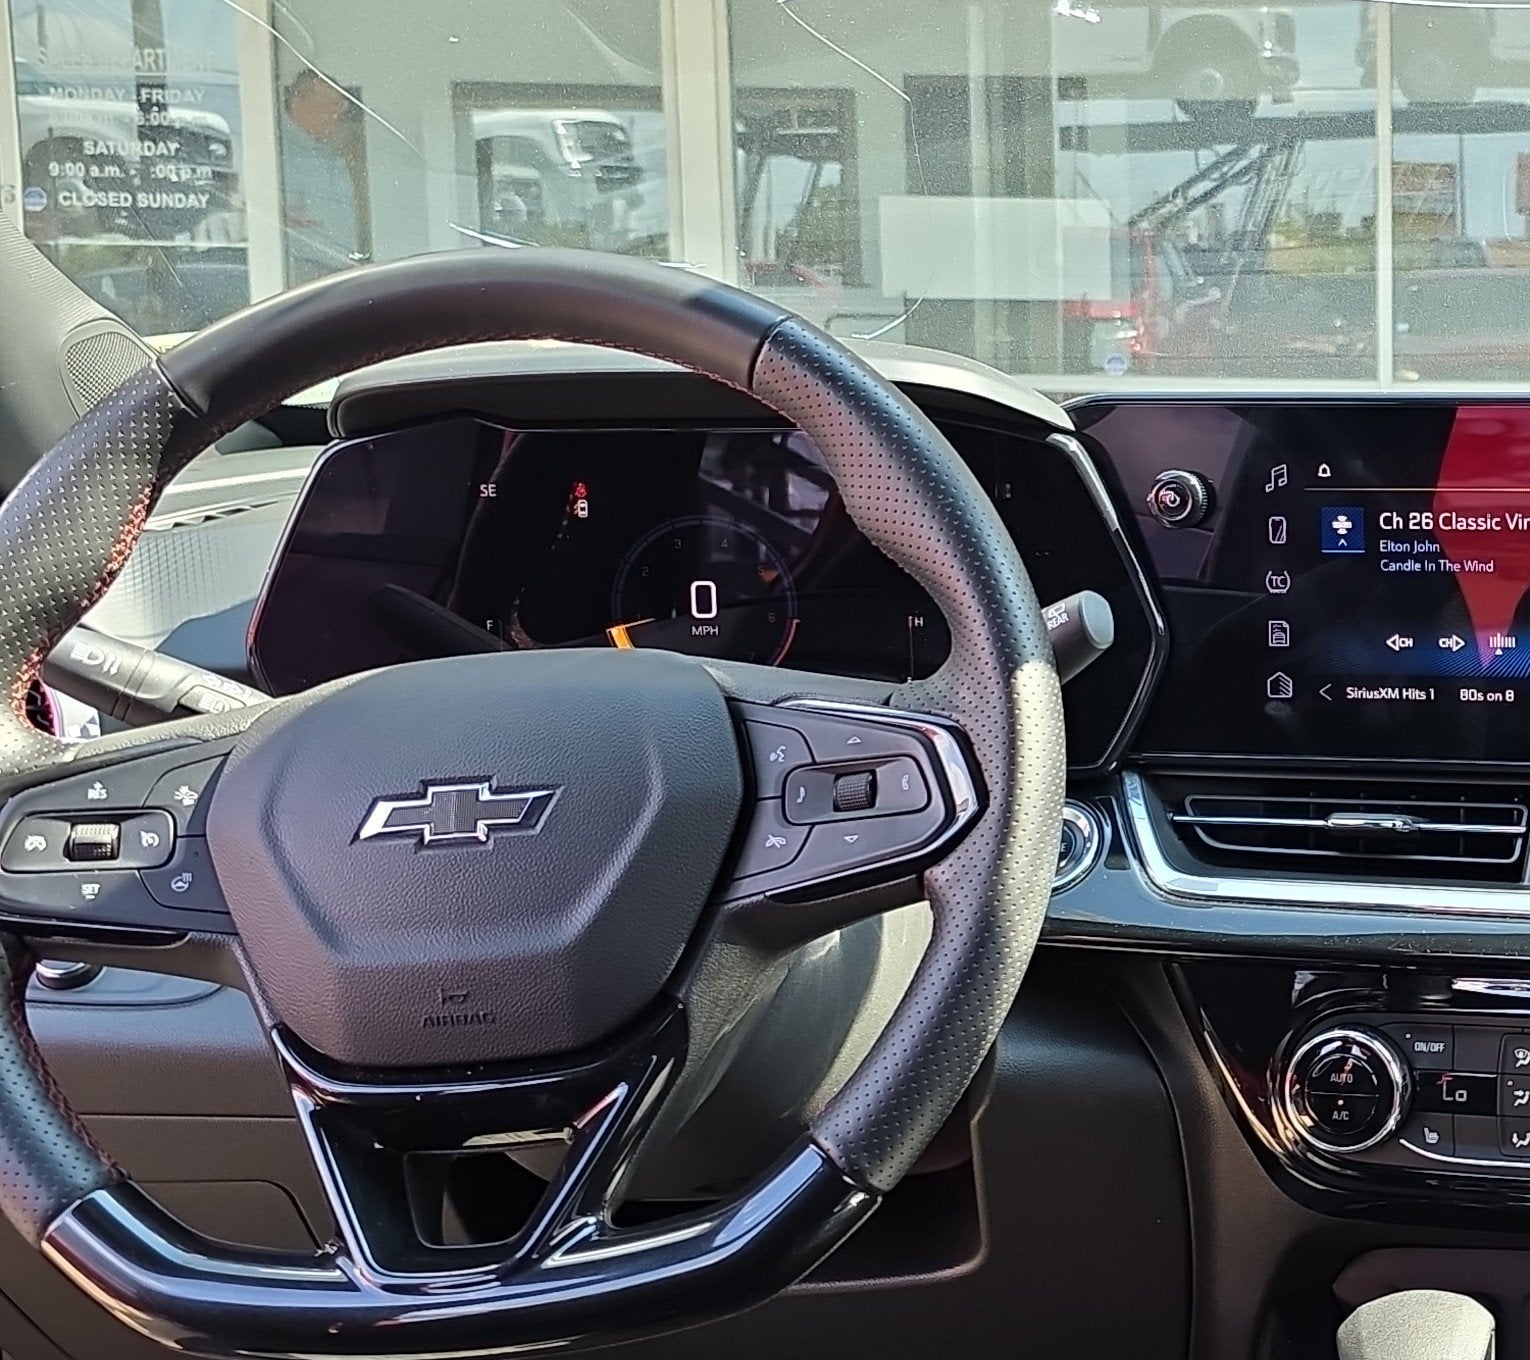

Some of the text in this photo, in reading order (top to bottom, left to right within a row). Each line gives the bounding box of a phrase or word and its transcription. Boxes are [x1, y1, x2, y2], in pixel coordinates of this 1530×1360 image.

[140, 90, 205, 103] FRIDAY
[82, 141, 180, 156] SATURDAY
[49, 161, 85, 178] 9:00
[57, 192, 211, 209] CLOSED SUNDAY
[1379, 512, 1403, 531] Ch
[1408, 512, 1433, 531] 26
[1438, 512, 1501, 531] Classic
[1379, 539, 1440, 554] Elton John
[1379, 558, 1494, 574] Candle In The Wind
[690, 580, 718, 619] 0
[691, 625, 719, 637] MPH
[1346, 686, 1435, 701] SiriusXM Hits 1
[1486, 692, 1504, 703] on
[421, 1011, 495, 1029] AIRBAG
[1414, 1041, 1446, 1053] ON/OFF
[1329, 1072, 1354, 1084] AUTO
[1331, 1110, 1350, 1121] A/C
